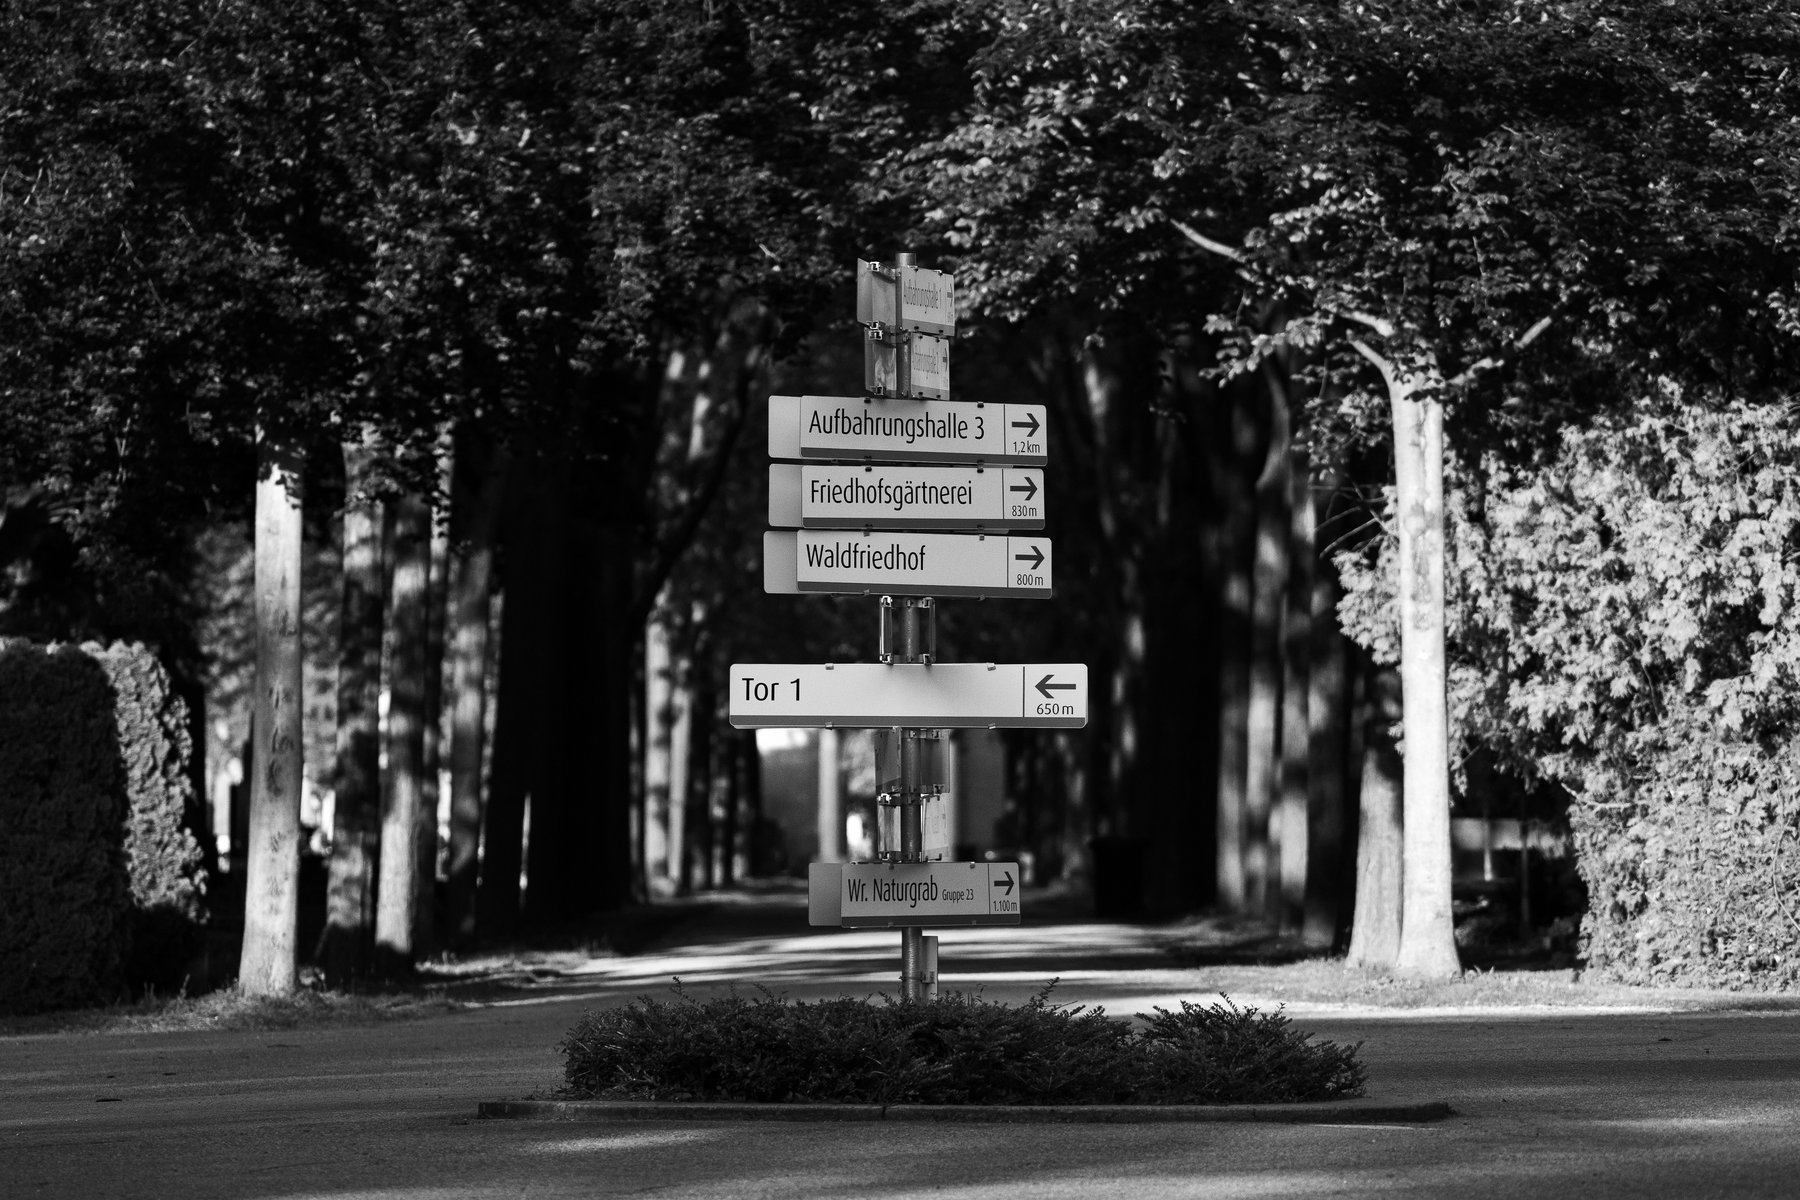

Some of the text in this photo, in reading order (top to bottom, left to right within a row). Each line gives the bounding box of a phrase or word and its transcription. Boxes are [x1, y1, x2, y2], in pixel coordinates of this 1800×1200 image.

[808, 407, 985, 445] Aufbahrungshalle 3
[811, 476, 972, 512] Friedhofsgärtnerei
[805, 541, 926, 571] Waldfriedhof
[741, 677, 801, 702] Tor 1
[847, 875, 974, 909] Wr. Naturgrab Gruppe 23
